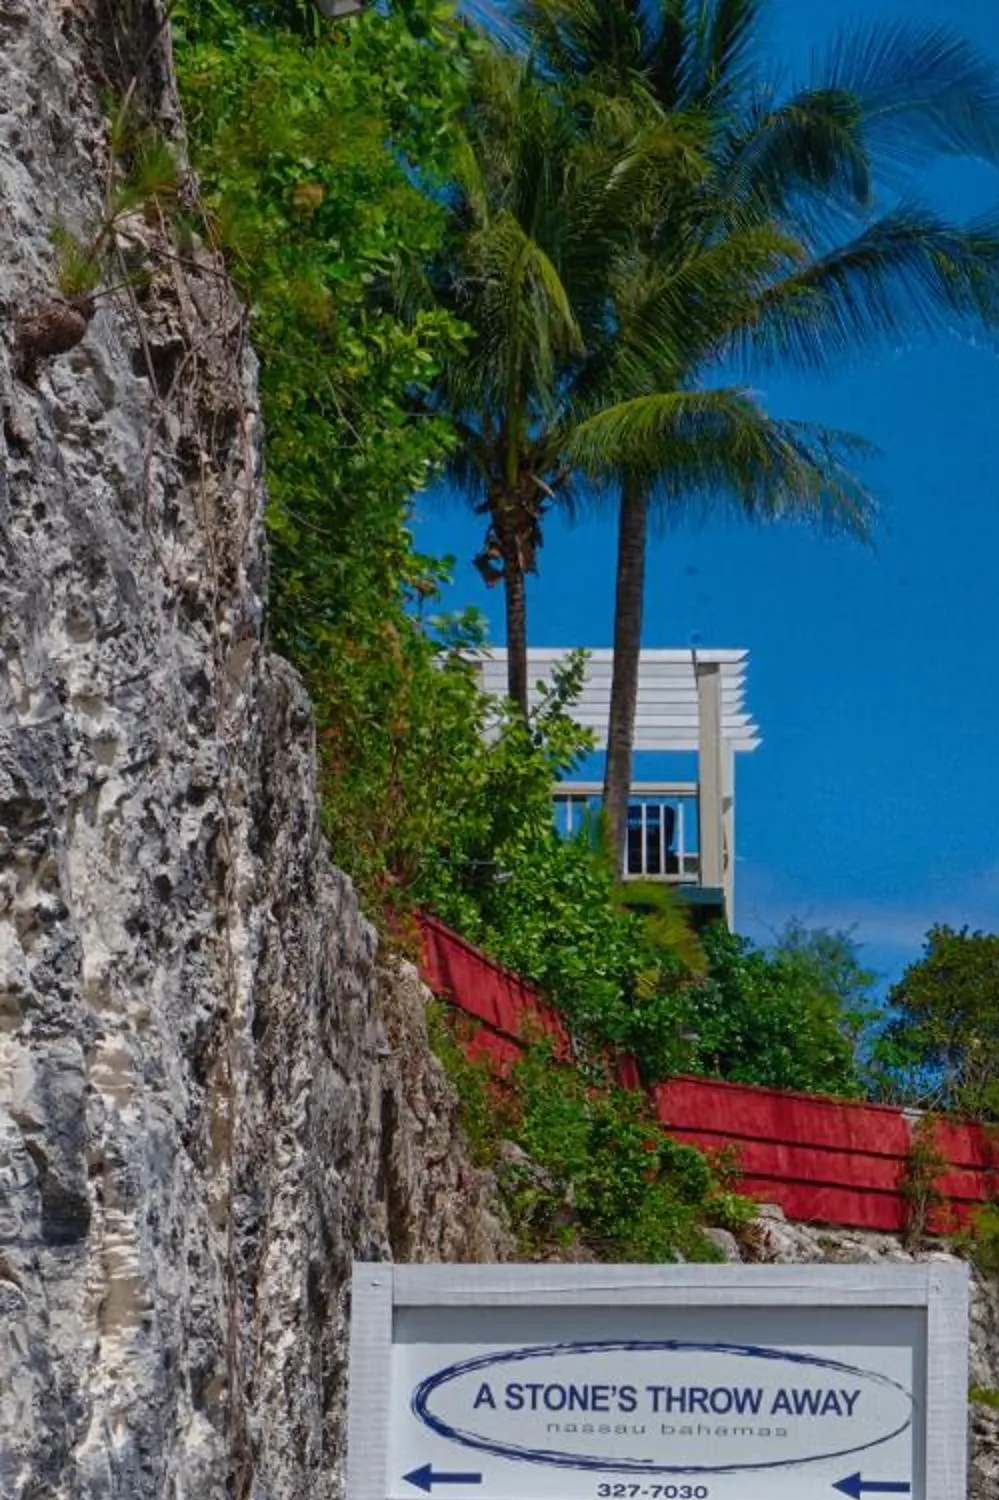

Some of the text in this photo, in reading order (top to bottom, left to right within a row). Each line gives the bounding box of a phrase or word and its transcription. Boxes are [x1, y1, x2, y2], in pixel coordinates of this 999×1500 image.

[473, 1383, 861, 1416] A STONE'S THROW AWAY
[546, 1422, 788, 1438] nassau bahamas
[597, 1483, 708, 1500] 327-7030
